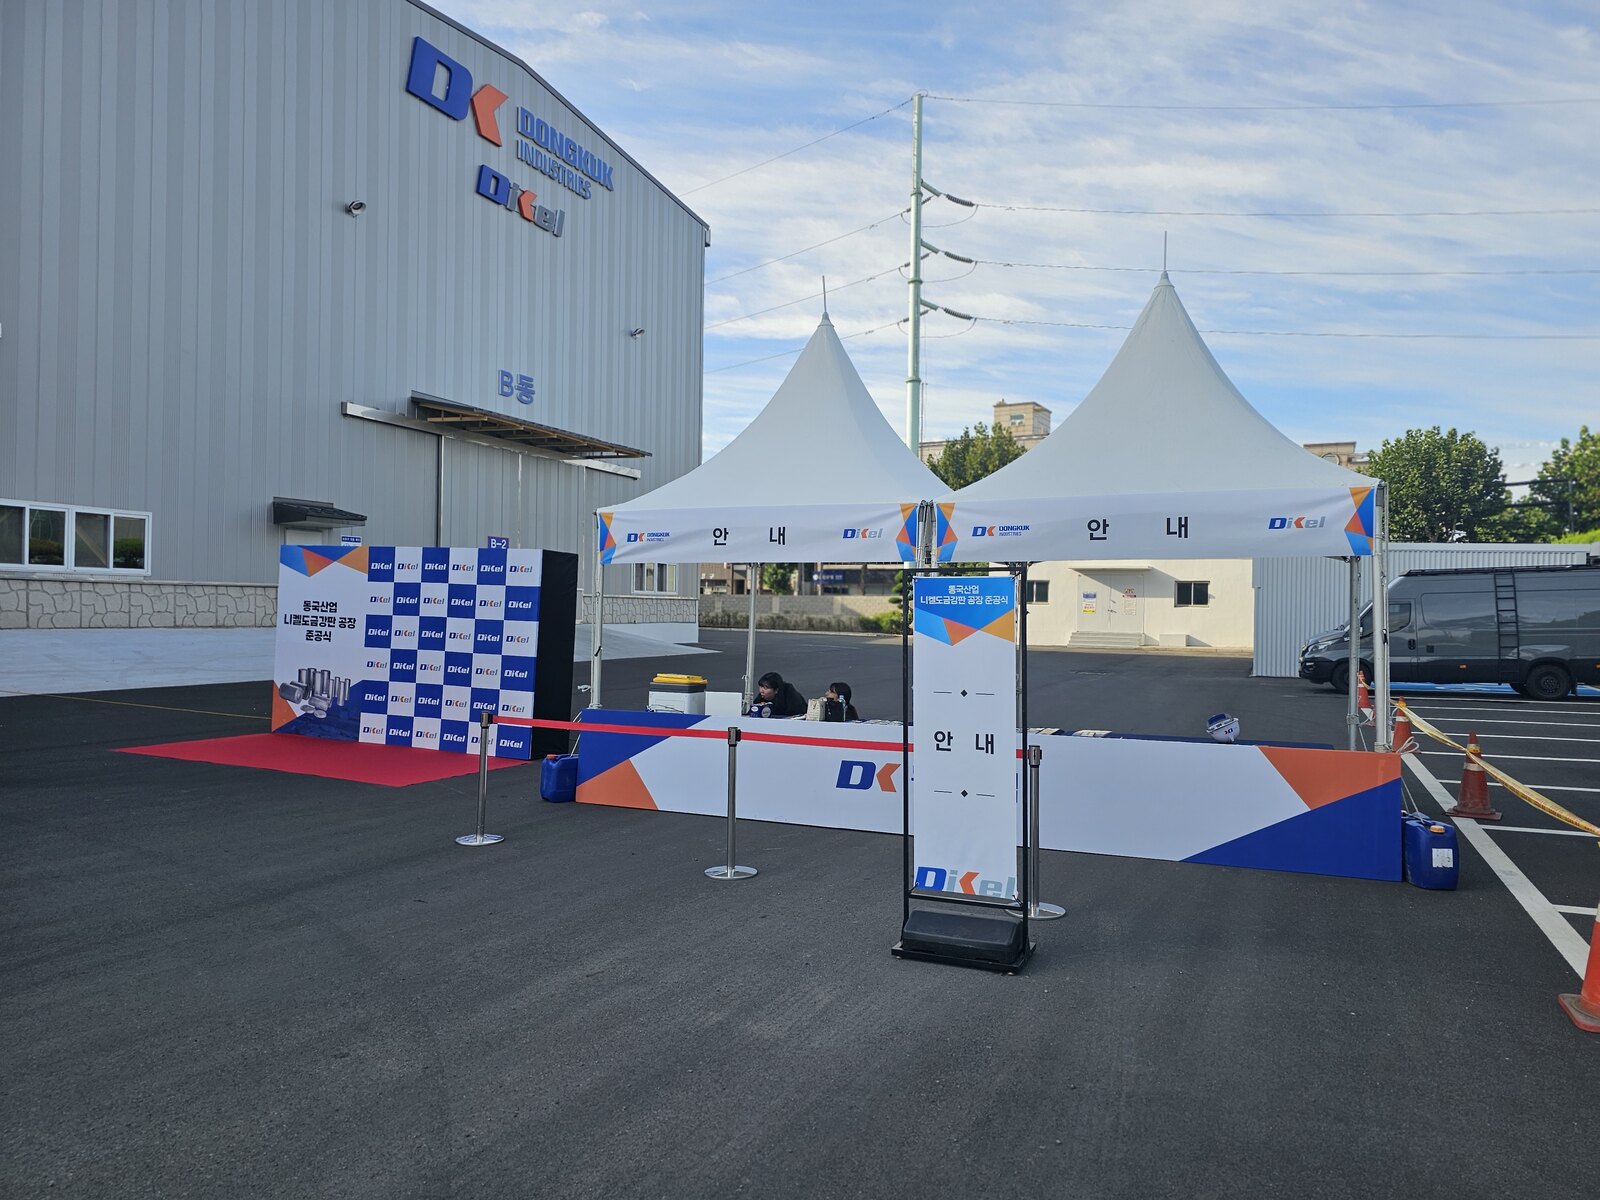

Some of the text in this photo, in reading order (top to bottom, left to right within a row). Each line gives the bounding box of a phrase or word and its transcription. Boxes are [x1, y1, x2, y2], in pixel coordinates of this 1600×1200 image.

[516, 106, 614, 191] DONGKUK
[516, 139, 592, 200] INDUSTRIES
[498, 369, 535, 404] B동
[713, 526, 786, 546] 안 내
[1087, 516, 1188, 540] 안 내
[491, 539, 506, 549] B-2
[948, 585, 979, 594] 동국산업
[303, 600, 338, 613] 동국산업
[920, 595, 1008, 605] 니켈도금강판 공장 준공식
[284, 613, 356, 629] 니켈도금강판 공장
[305, 629, 332, 642] 준공식
[934, 731, 994, 755] 안 내
